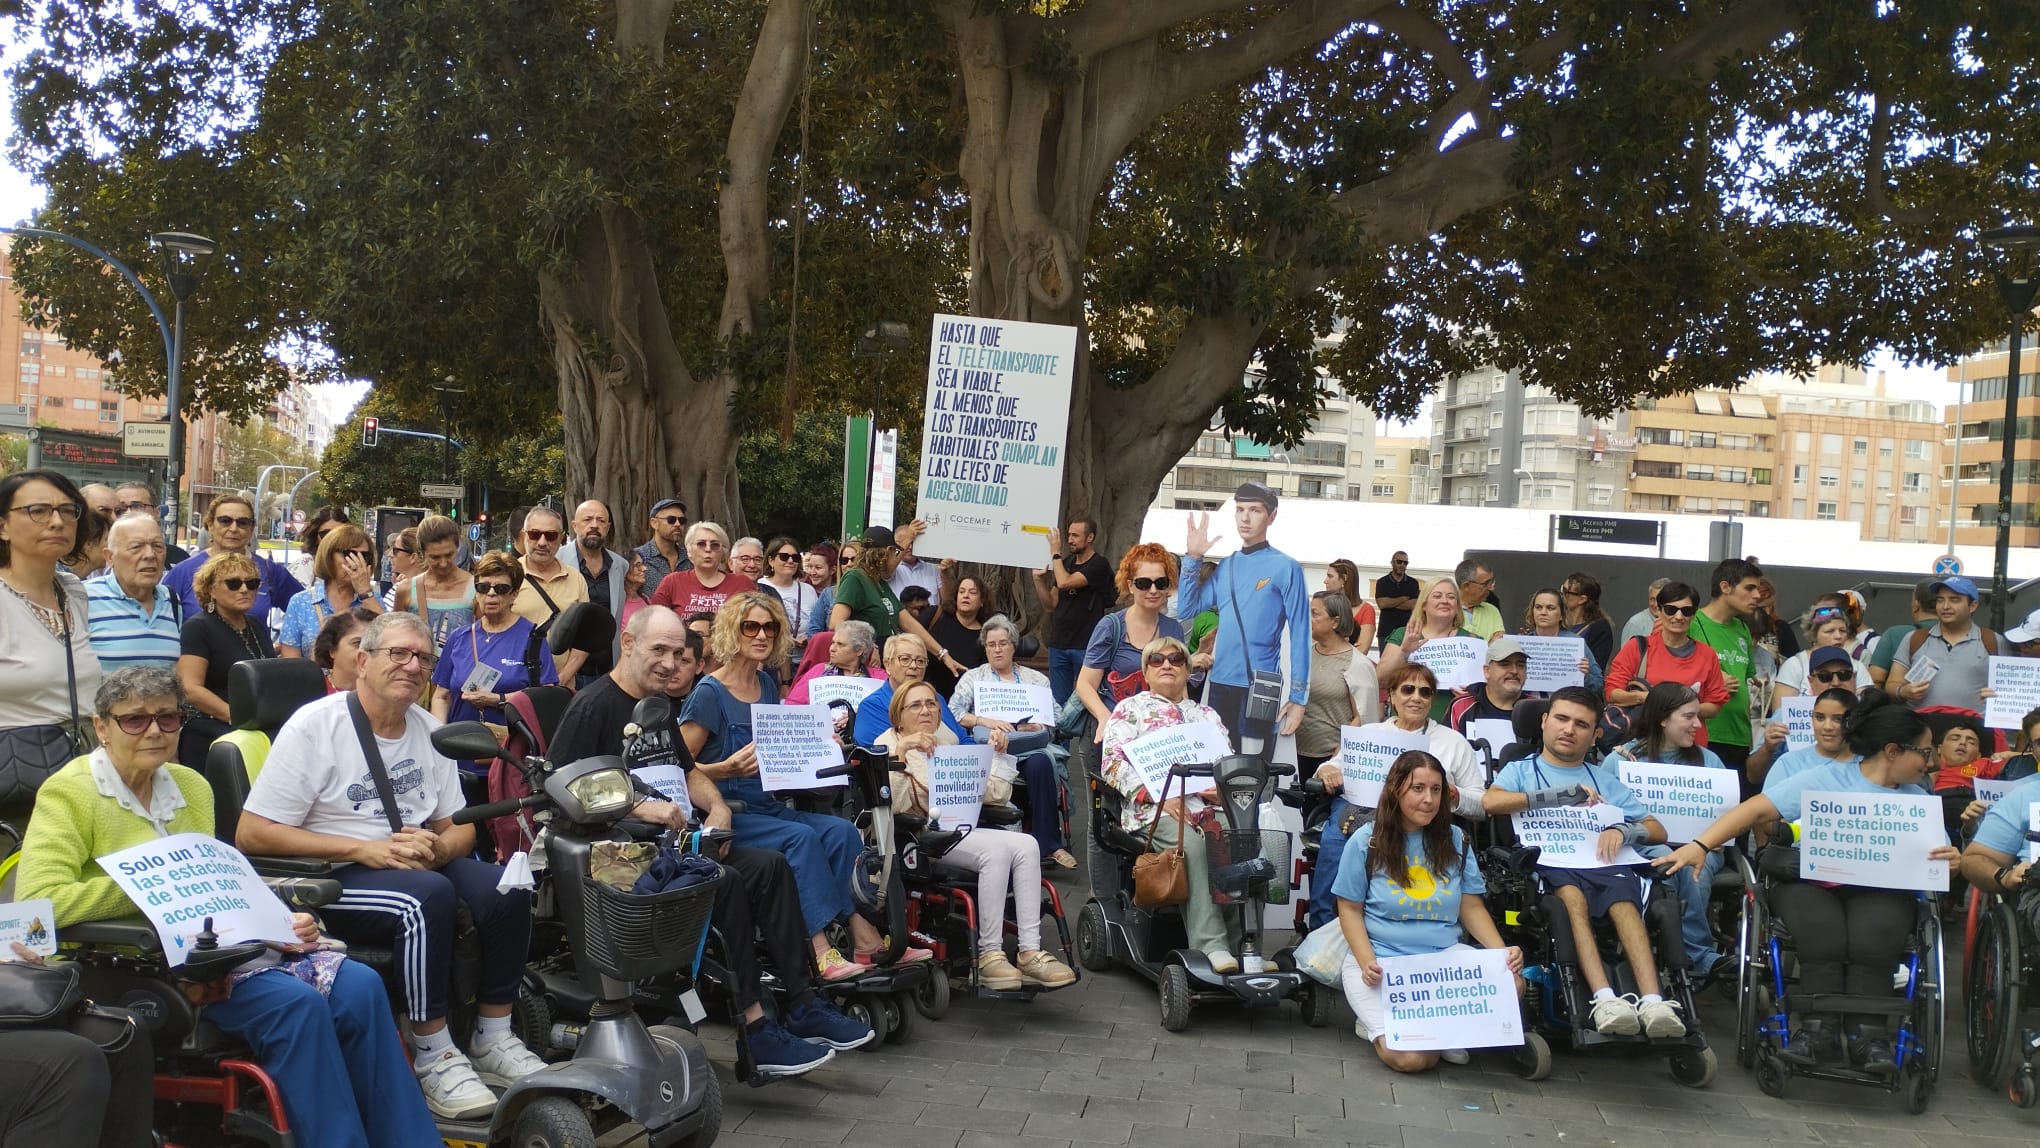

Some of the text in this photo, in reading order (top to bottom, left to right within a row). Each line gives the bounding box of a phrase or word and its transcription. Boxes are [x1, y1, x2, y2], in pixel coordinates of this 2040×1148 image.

[939, 322, 1003, 348] HASTA QUE
[937, 345, 952, 365] EL
[935, 367, 1003, 393] SEA VIABLE,
[933, 390, 1019, 418] AL MENOS QUE
[931, 412, 1037, 441] LOS TRANSPORTES
[929, 435, 1058, 467] HABITUALES CUMPLAN
[927, 457, 1010, 484] LAS LEYES DE
[925, 479, 1009, 507] ACCESIBILIDAD.
[950, 514, 992, 526] COCEMFE
[1413, 650, 1476, 660] accesibilidad
[1416, 642, 1469, 652] omentar la
[1996, 663, 2035, 671] Abogamos
[814, 690, 852, 700] garantizar
[825, 683, 864, 692] necesario
[756, 712, 765, 720] Los
[1789, 718, 1811, 730] más
[765, 744, 788, 752] siempre
[791, 736, 822, 744] transportes
[1132, 733, 1186, 756] Protección
[1343, 738, 1406, 756] Necesitamos
[934, 755, 978, 767] Protección
[1139, 741, 1205, 764] de equipos de
[1343, 752, 1384, 768] más taxis
[773, 760, 797, 768] personas
[1143, 753, 1198, 773] movilidad y
[934, 769, 946, 780] de
[949, 768, 979, 781] equipos
[1343, 767, 1387, 783] adaptados
[1627, 772, 1713, 790] La movilidad
[935, 780, 979, 793] movilidad y
[935, 794, 977, 805] asistencia
[1647, 790, 1664, 800] un
[1669, 789, 1724, 805] derecho
[1586, 809, 1598, 820] la
[1641, 802, 1717, 819] ndamental.
[1810, 800, 1926, 818] Solo un 18% de
[1522, 819, 1606, 833] accesibilidad
[1809, 814, 1919, 832] las estaciones
[1525, 832, 1586, 841] en zonas
[1809, 828, 1896, 846] de tren son
[1541, 843, 1576, 854] rales
[1809, 846, 1890, 862] accesibles
[118, 854, 165, 876] Solo
[168, 848, 194, 863] un
[131, 861, 248, 891] las estaciones
[146, 877, 243, 906] de tren son
[162, 895, 250, 925] accesibles
[1386, 965, 1483, 987] La movilidad
[1389, 982, 1497, 1003] es un derecho
[1391, 999, 1494, 1020] fundamental.
